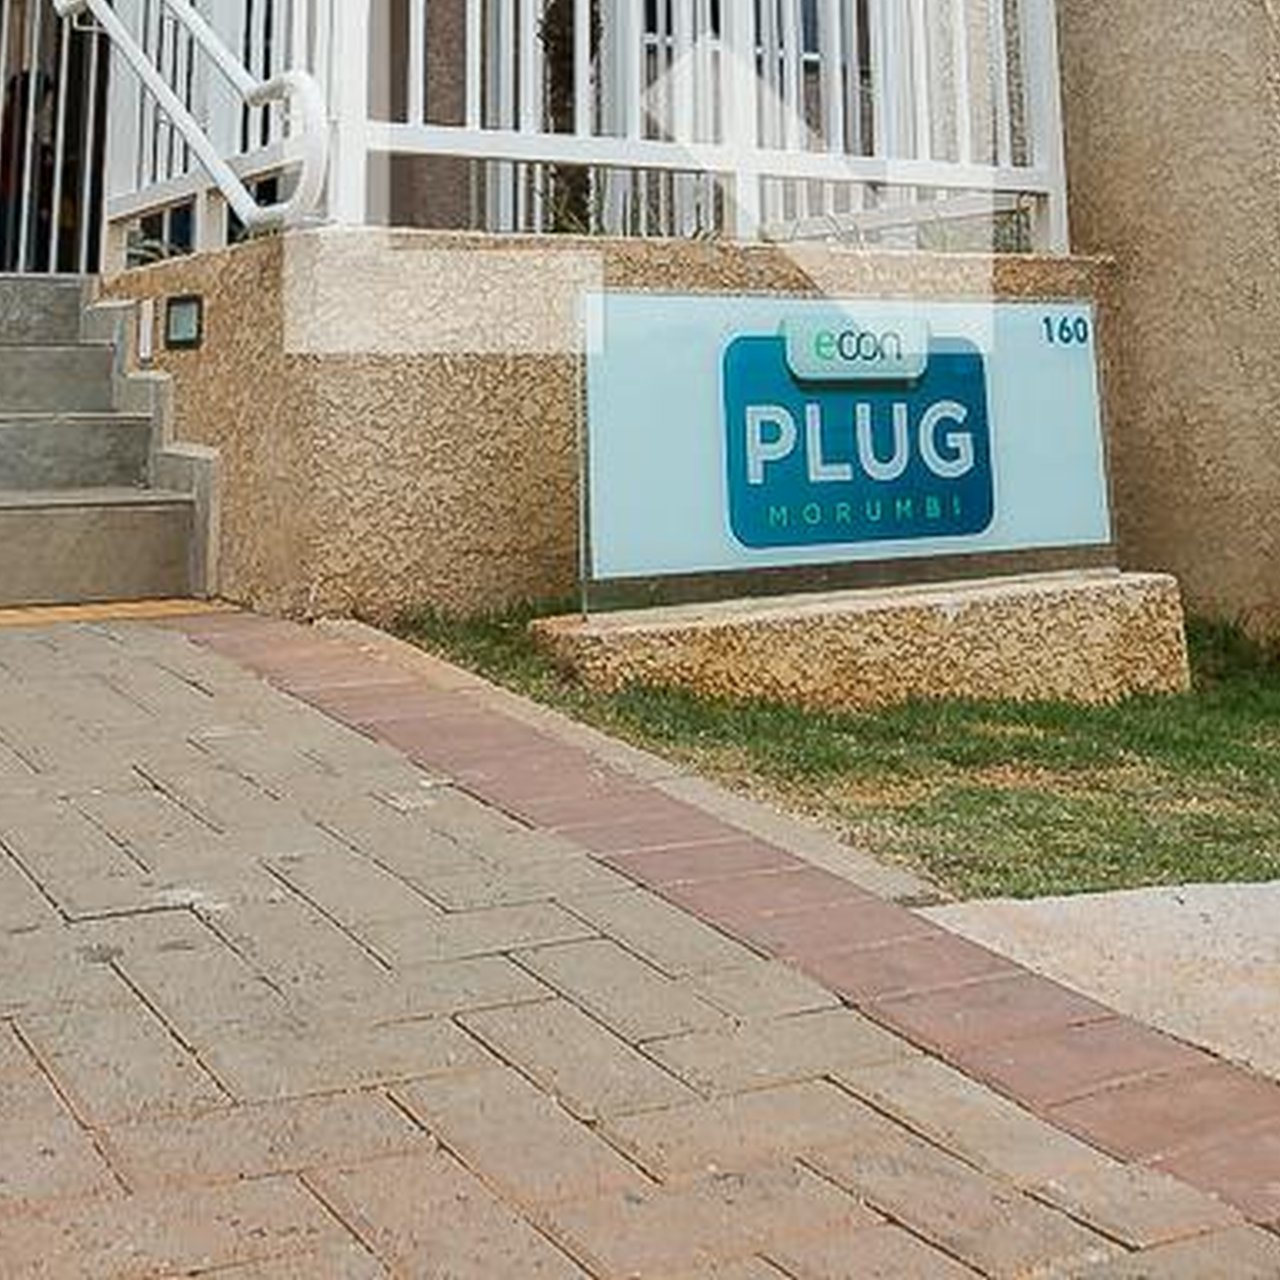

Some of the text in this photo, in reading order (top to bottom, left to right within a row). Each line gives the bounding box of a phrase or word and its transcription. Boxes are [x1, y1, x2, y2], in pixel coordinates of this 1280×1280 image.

[815, 330, 902, 361] econ
[1043, 316, 1088, 344] 160
[745, 398, 975, 485] PLUG
[769, 493, 961, 528] MORUMBI
